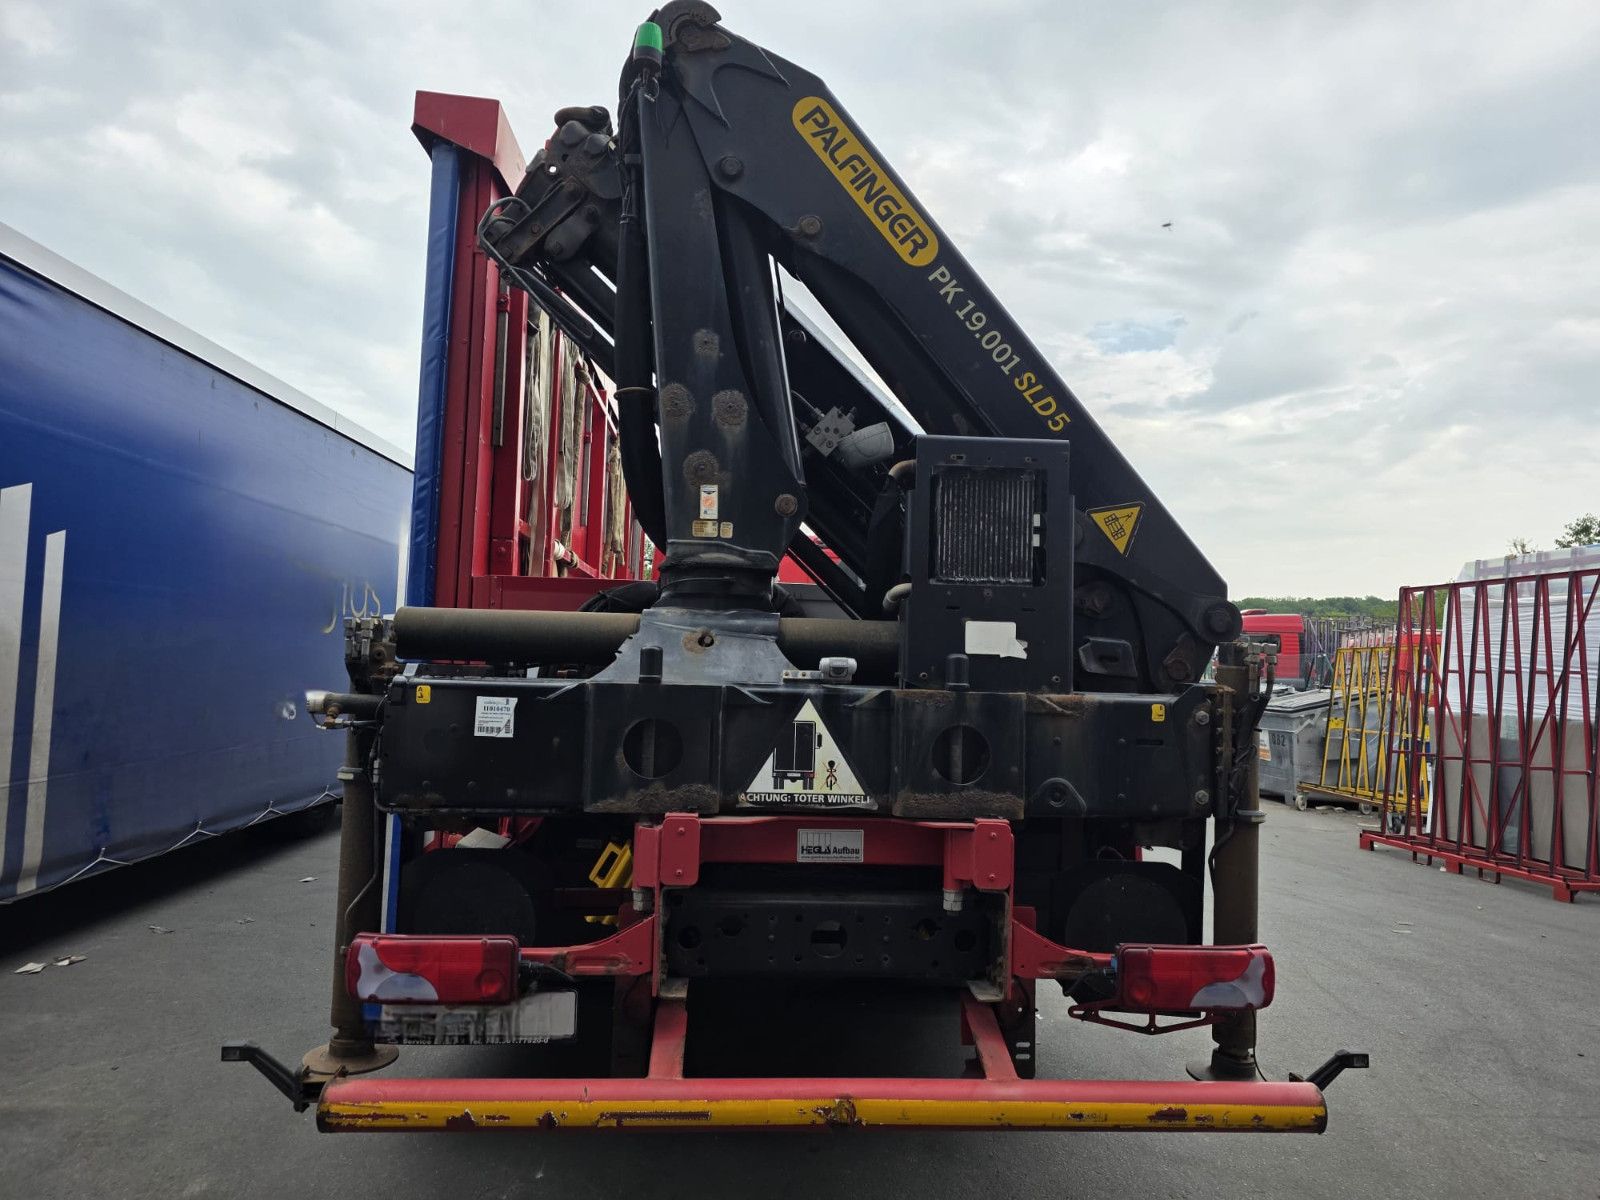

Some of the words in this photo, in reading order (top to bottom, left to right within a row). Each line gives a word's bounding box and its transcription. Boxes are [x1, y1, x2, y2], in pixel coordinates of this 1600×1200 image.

[799, 105, 929, 259] PALFINGER
[928, 266, 964, 304] PK
[956, 300, 1021, 375] 19.001
[1014, 371, 1071, 432] SLD5
[739, 792, 791, 802] ACHTUNG:
[793, 793, 825, 803] TOTER
[832, 846, 860, 855] Aufbau
